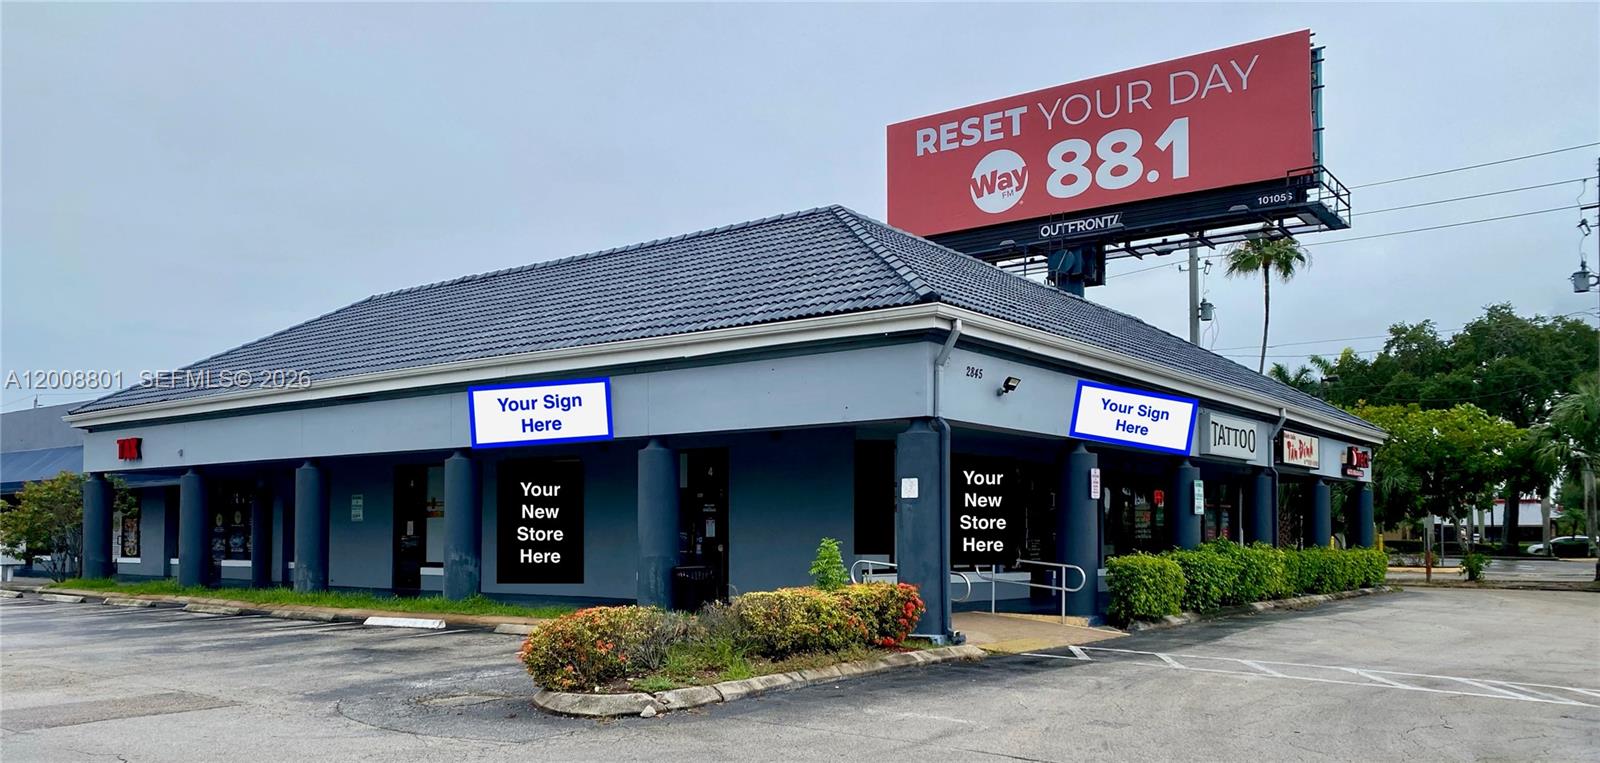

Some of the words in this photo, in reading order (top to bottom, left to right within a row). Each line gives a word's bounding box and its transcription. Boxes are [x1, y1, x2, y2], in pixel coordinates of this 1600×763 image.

[916, 106, 1028, 157] RESET
[1037, 80, 1153, 130] YOUR
[1169, 54, 1260, 105] DAY
[1046, 117, 1190, 199] 88.1
[970, 166, 1028, 199] Way
[1002, 189, 1015, 199] FM
[966, 366, 983, 380] 2845
[1211, 420, 1256, 453] TATTOO
